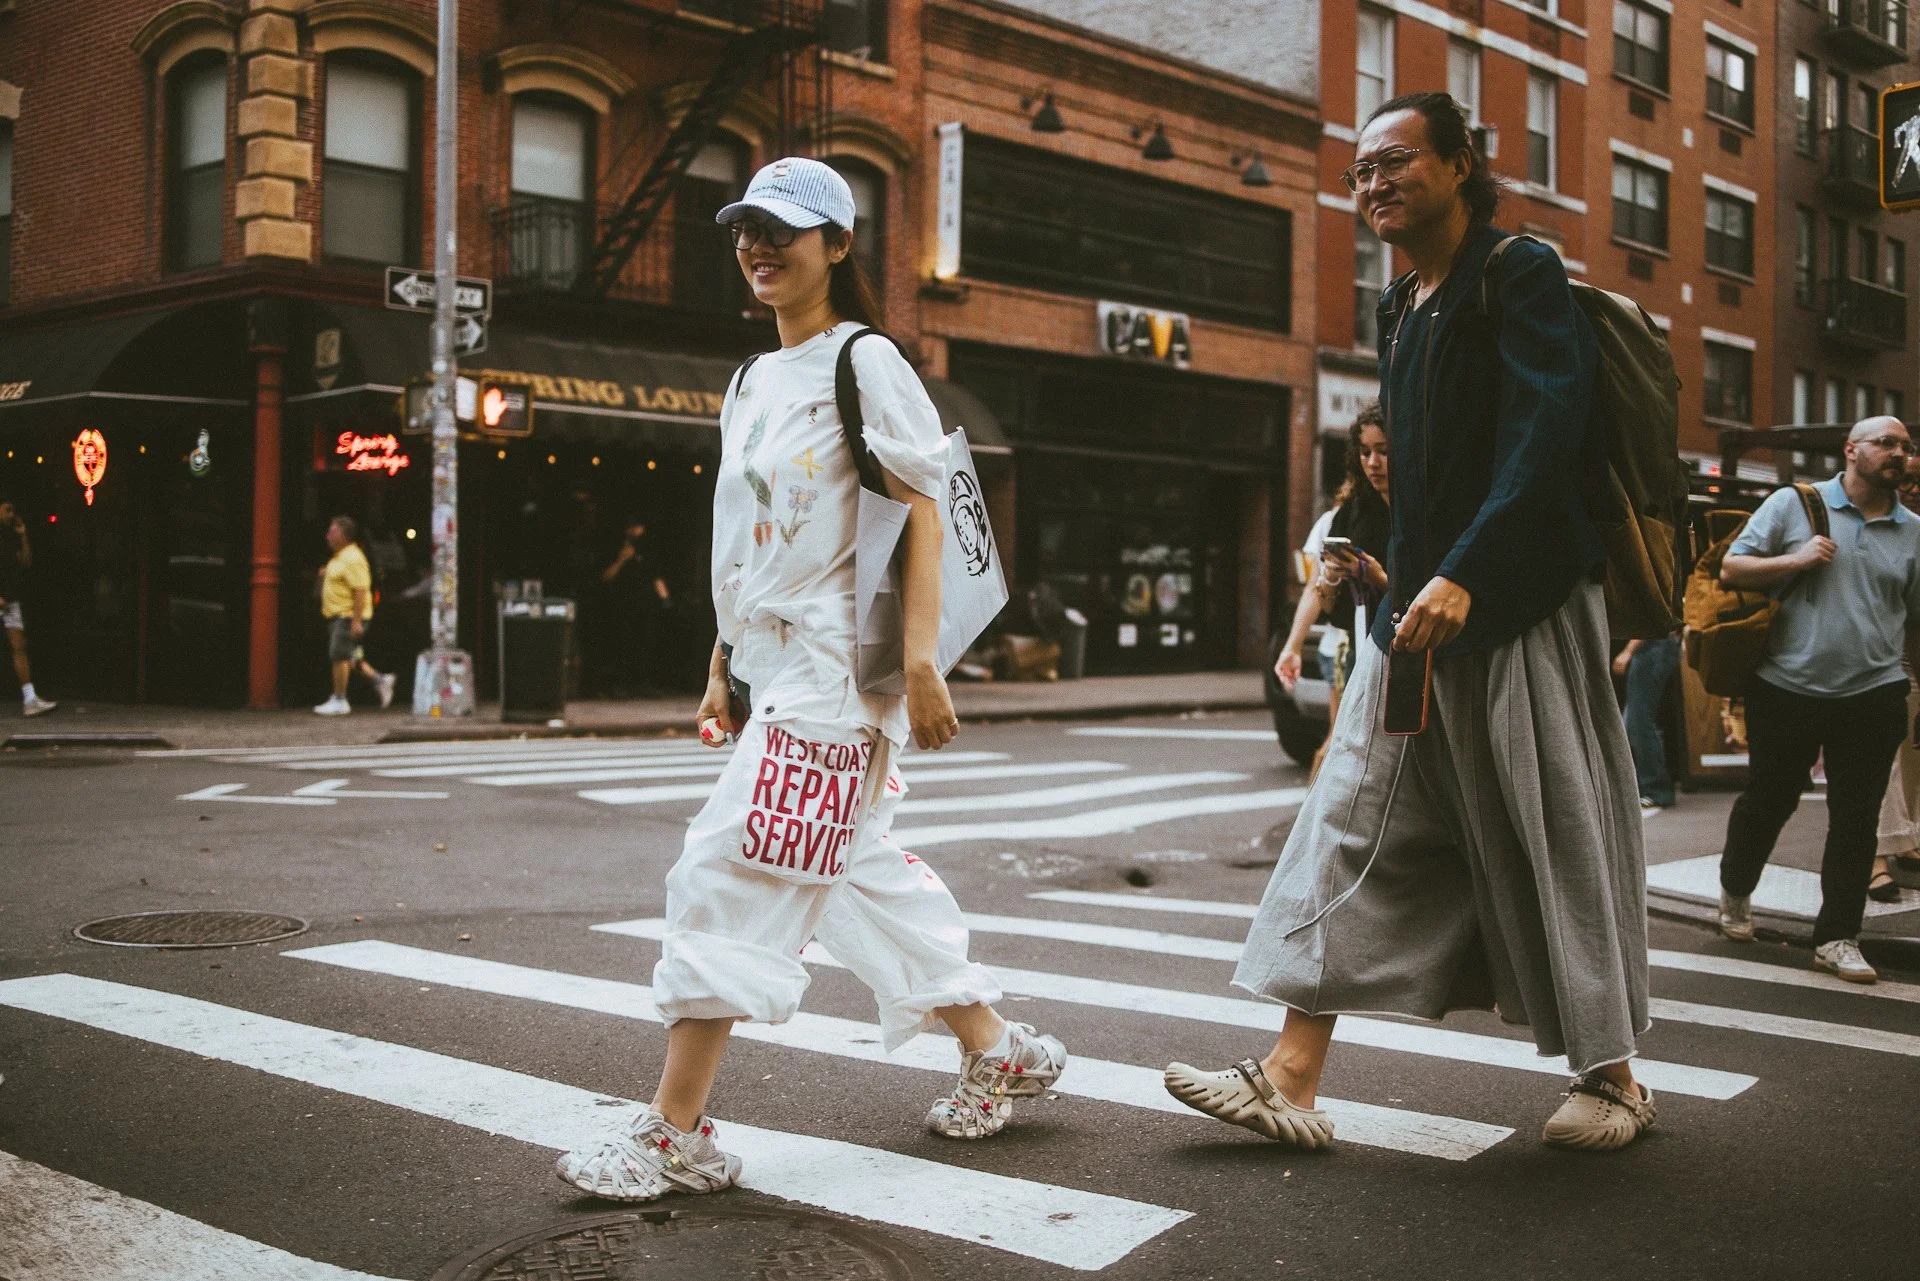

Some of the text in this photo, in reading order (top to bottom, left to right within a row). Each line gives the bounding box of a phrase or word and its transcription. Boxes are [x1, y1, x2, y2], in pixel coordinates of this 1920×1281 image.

[632, 384, 726, 415] LOUN
[766, 726, 870, 772] WEST COAS
[742, 809, 855, 877] SERVIC
